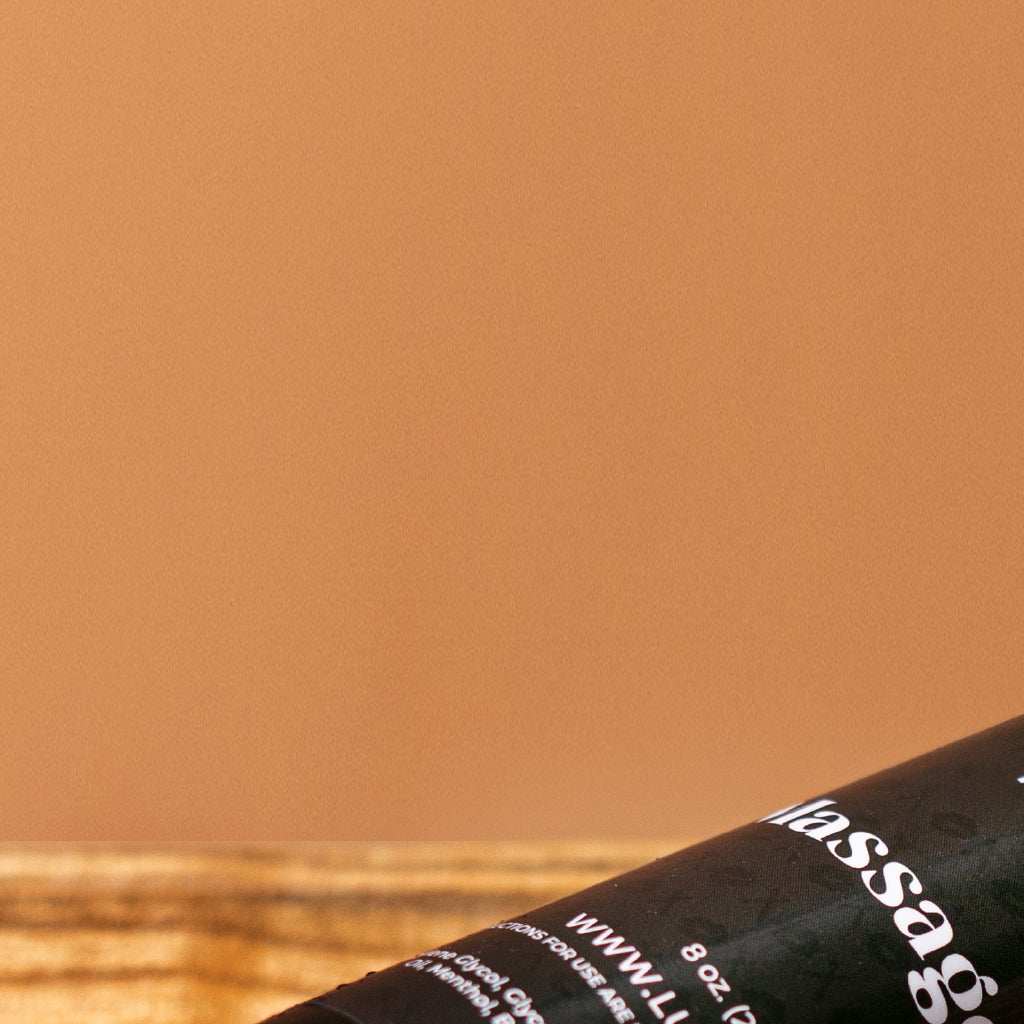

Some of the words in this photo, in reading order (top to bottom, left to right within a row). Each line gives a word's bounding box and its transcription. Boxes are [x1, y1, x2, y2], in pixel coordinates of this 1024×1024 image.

[427, 962, 501, 1018] Menthol,
[453, 954, 511, 993] Glycol,
[541, 935, 577, 961] FOR
[570, 956, 607, 989] USE
[595, 987, 635, 1024] ARE
[680, 942, 708, 962] 8
[697, 963, 731, 1003] oz.
